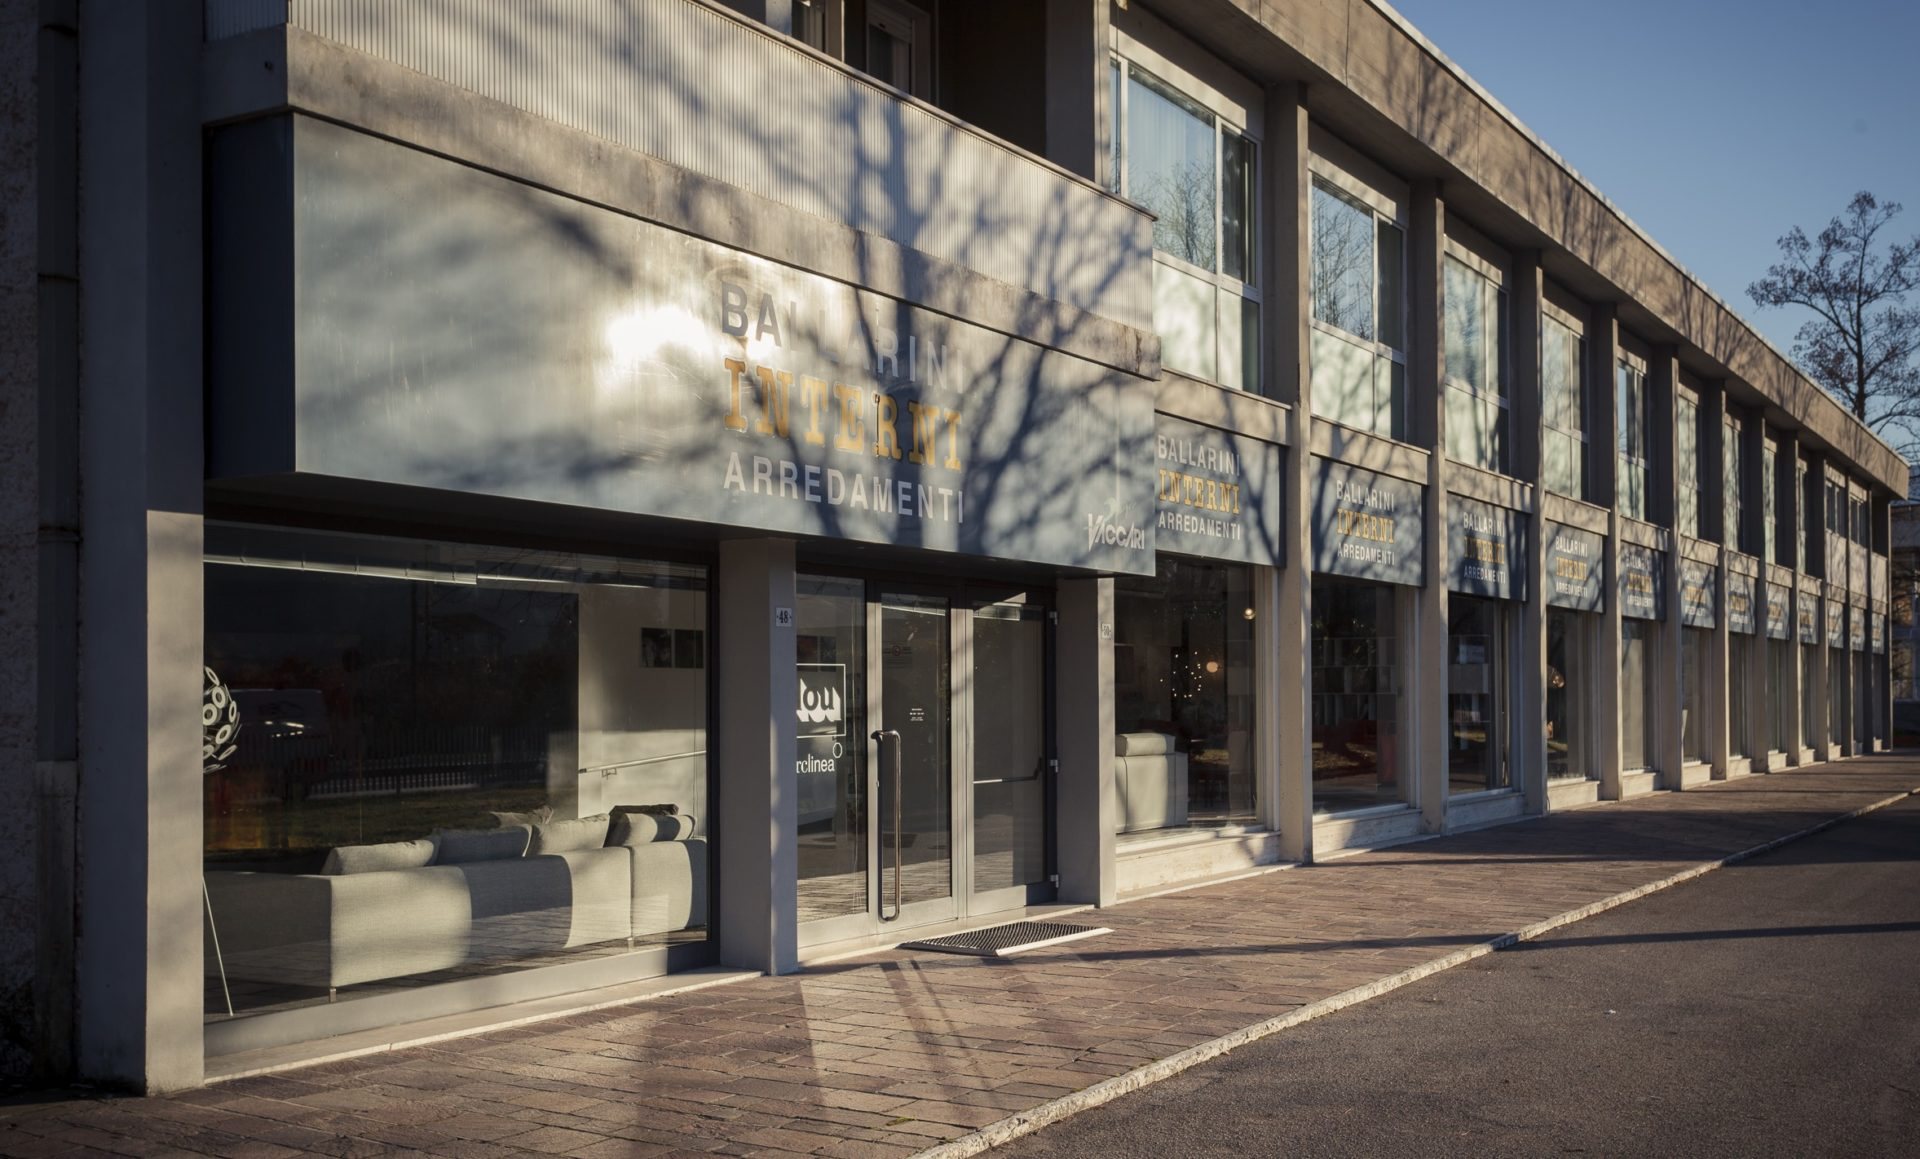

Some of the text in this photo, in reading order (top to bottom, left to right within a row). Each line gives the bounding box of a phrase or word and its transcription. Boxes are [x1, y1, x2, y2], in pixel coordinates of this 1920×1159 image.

[723, 356, 962, 471] INTERNI
[1157, 434, 1240, 477] BALLARINI
[723, 451, 964, 523] ARREDAMENTI
[1159, 468, 1240, 515] INTERNI
[1336, 479, 1395, 512] BALLARINI
[1088, 513, 1145, 551] VACCARI
[1158, 510, 1241, 540] ARREDAMENTI
[1336, 508, 1395, 544] INTERNI
[1463, 511, 1506, 538] BALLARINI
[1337, 542, 1395, 566] ARREDAMENTI
[1464, 535, 1505, 566] ITERNI
[778, 609, 789, 624] 48
